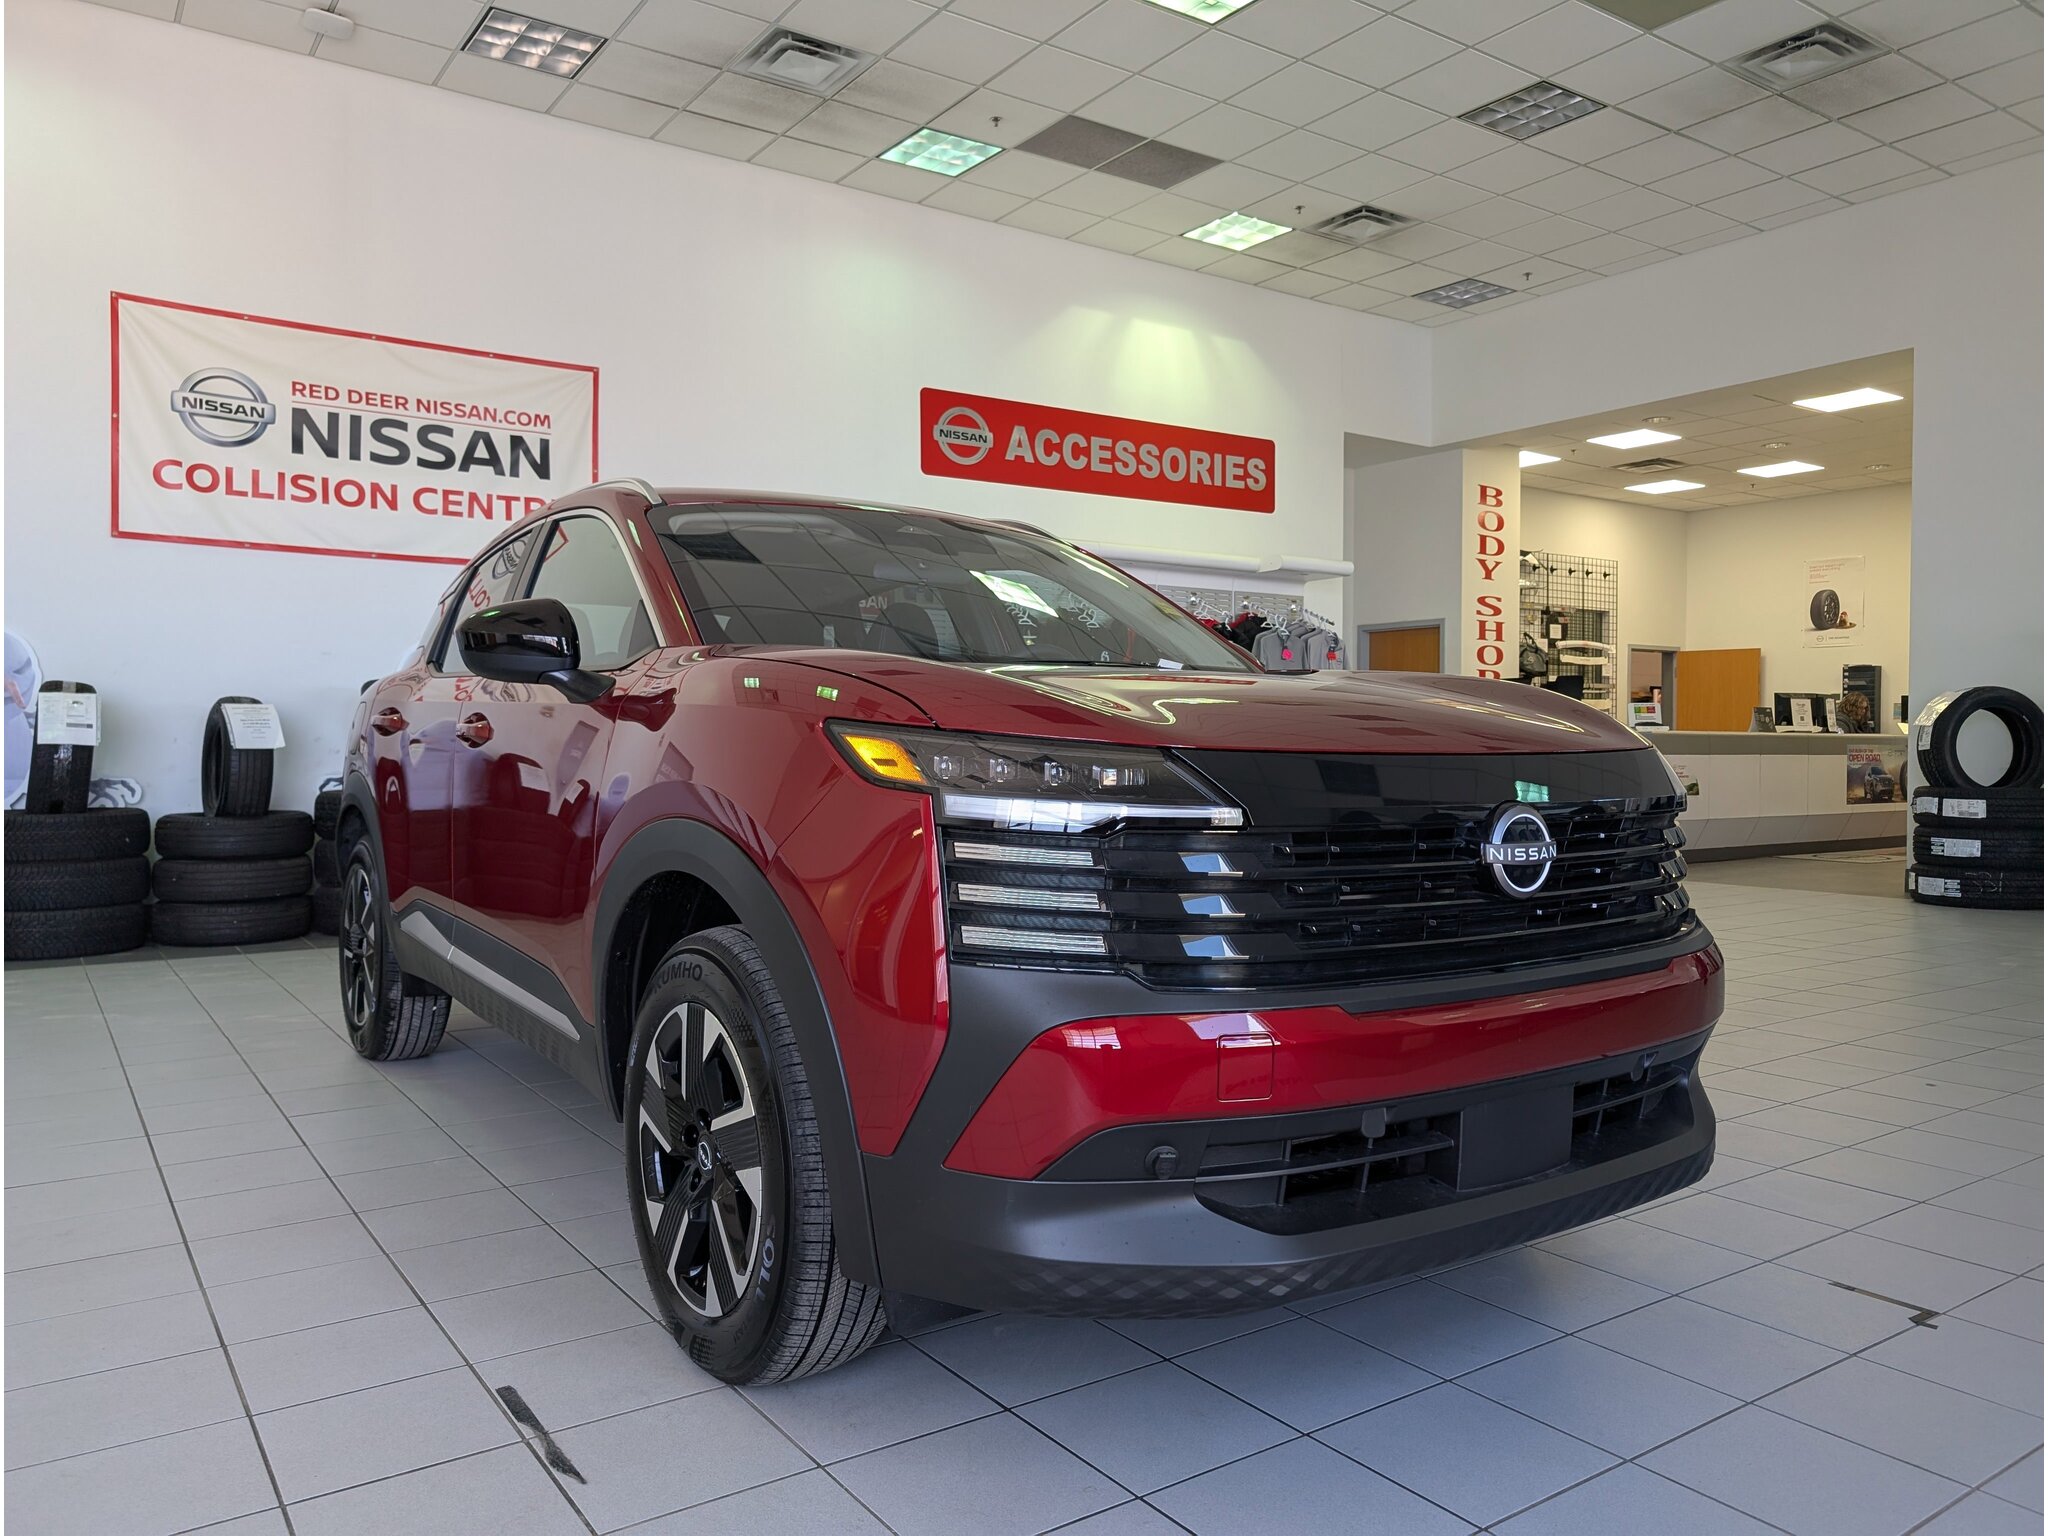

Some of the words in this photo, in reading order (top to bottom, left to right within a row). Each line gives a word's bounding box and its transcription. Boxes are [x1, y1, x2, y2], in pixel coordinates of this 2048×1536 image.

[182, 396, 265, 419] NISSAN
[291, 381, 340, 401] RED
[347, 388, 409, 412] DEER
[416, 398, 552, 430] NISSAN.COM
[291, 407, 551, 481] NISSAN
[939, 428, 988, 444] NISSAN
[1005, 425, 1267, 491] ACCESSORIES
[152, 459, 398, 511] COLLISION
[1475, 484, 1505, 581] BODY
[1848, 753, 1865, 762] OPEN
[1489, 844, 1557, 861] NISSAN
